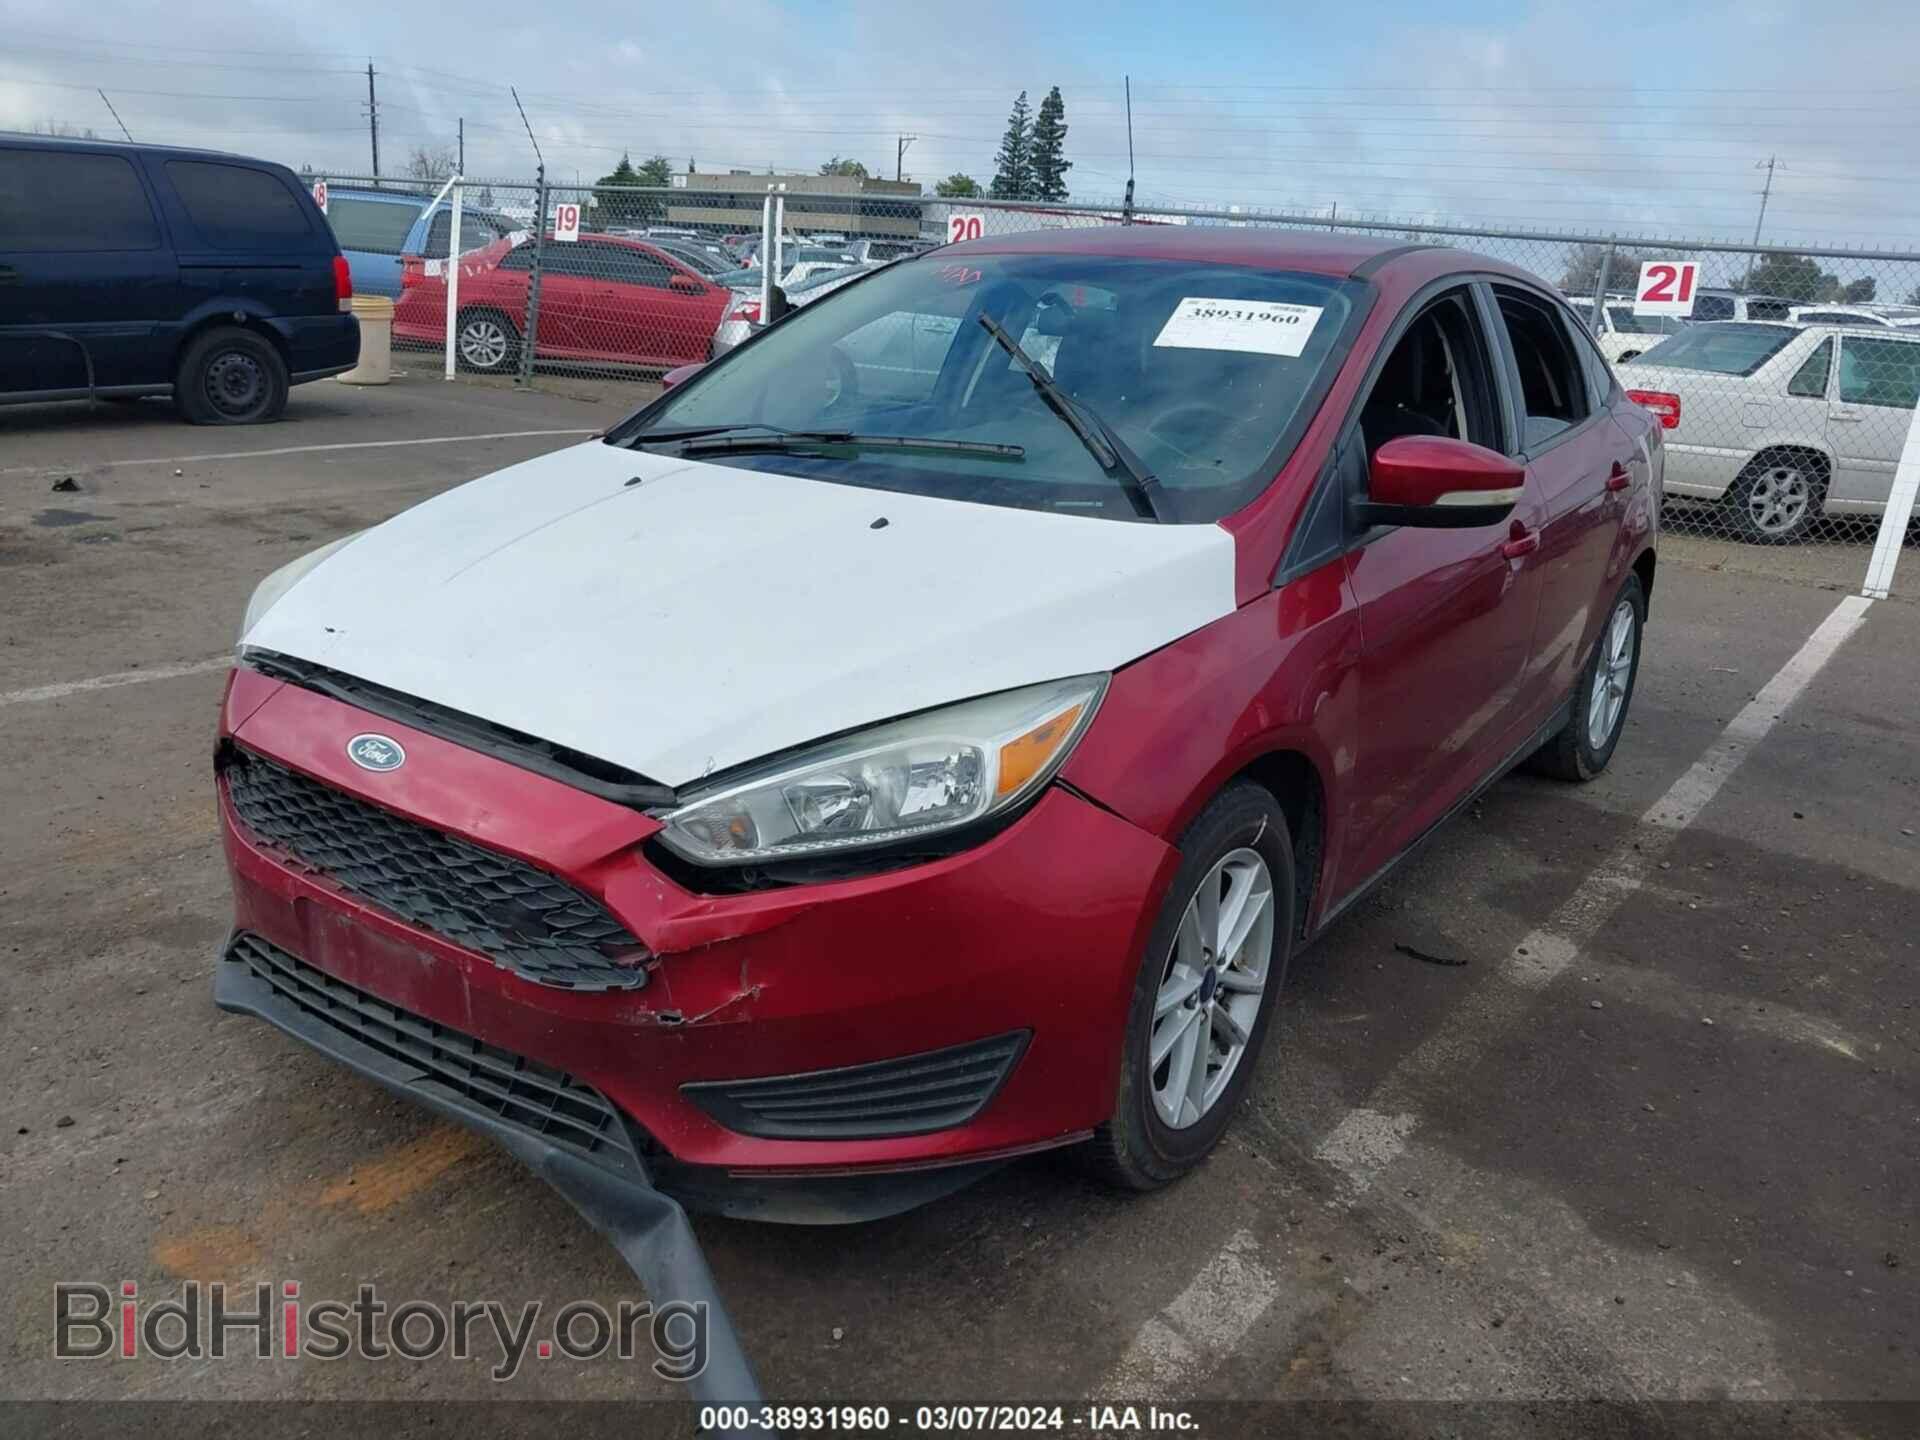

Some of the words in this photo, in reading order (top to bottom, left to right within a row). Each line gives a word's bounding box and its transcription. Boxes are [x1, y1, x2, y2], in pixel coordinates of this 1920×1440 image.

[558, 206, 577, 231] 19
[952, 217, 981, 243] 20
[1641, 265, 1695, 302] 21
[1187, 307, 1300, 326] 38931960
[357, 740, 393, 764] Ford
